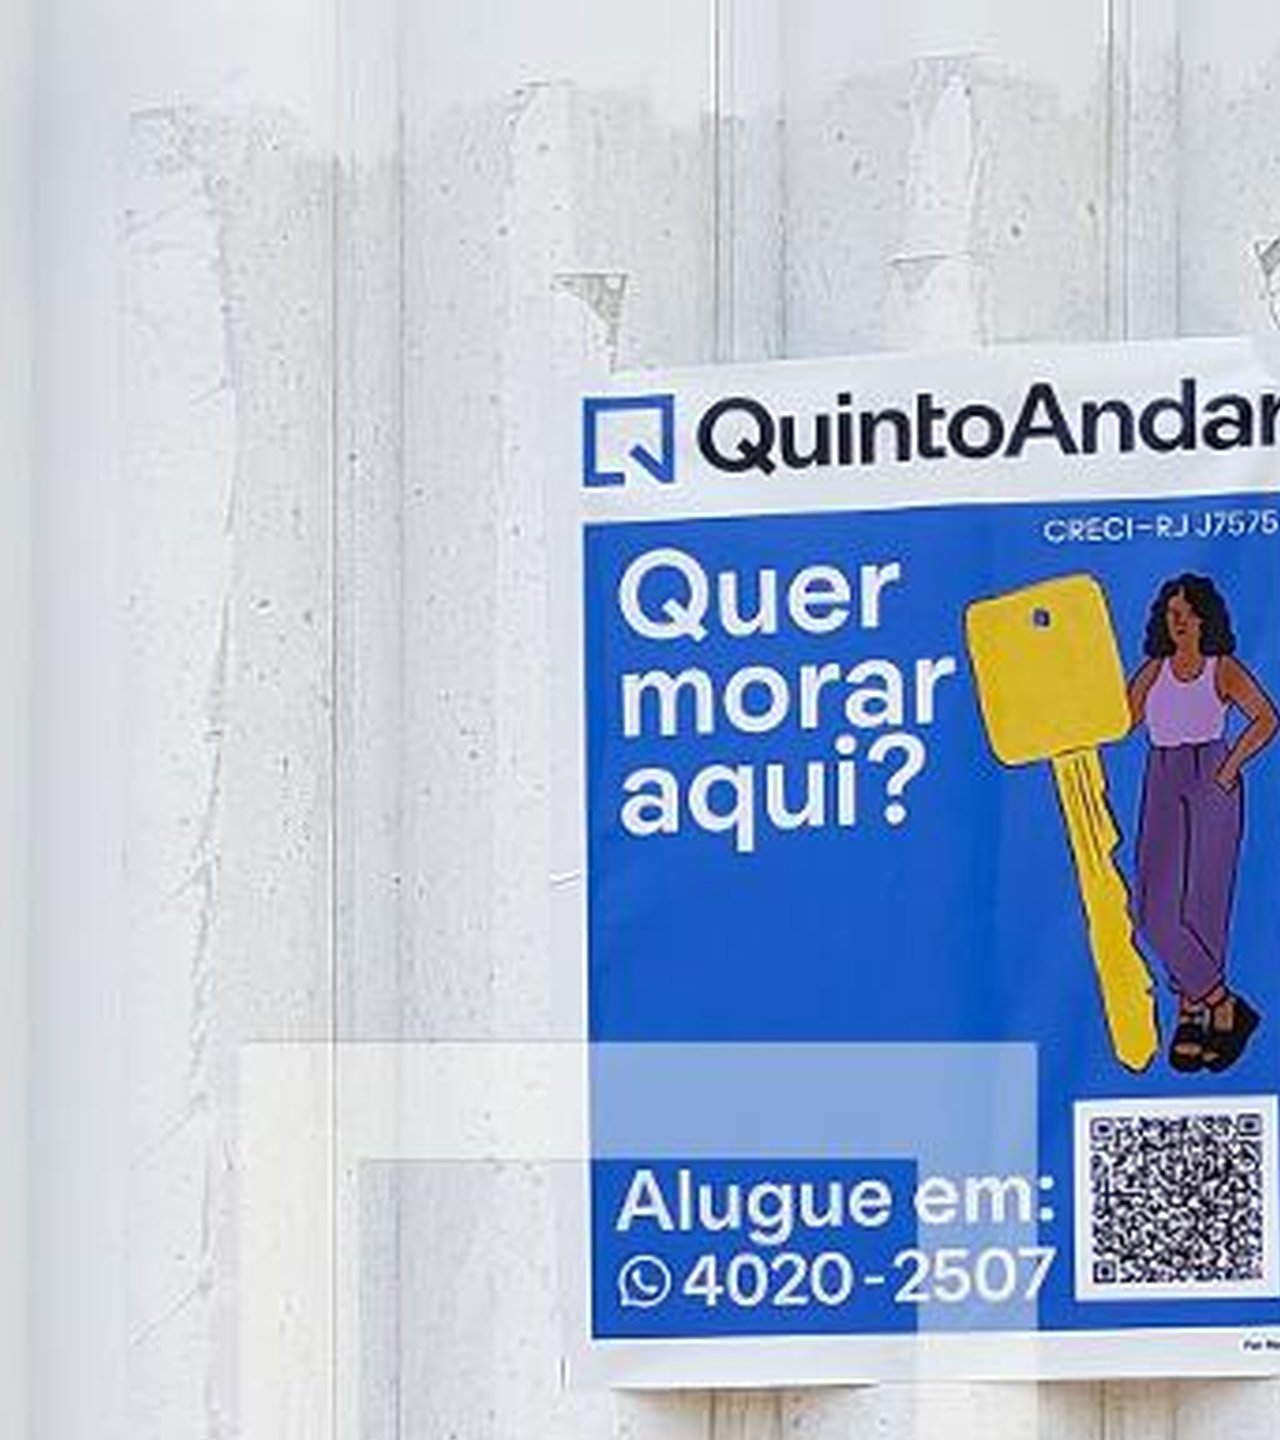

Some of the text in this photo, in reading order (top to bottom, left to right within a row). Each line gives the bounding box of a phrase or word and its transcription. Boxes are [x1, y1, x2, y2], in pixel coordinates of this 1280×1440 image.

[1042, 509, 1280, 544] CRECI-RJ J7575
[618, 547, 901, 643] Quer
[620, 654, 956, 737] morar
[620, 733, 926, 852] aqui?
[616, 1168, 1056, 1246] Alugue em:
[682, 1247, 1057, 1308] 4020-2507
